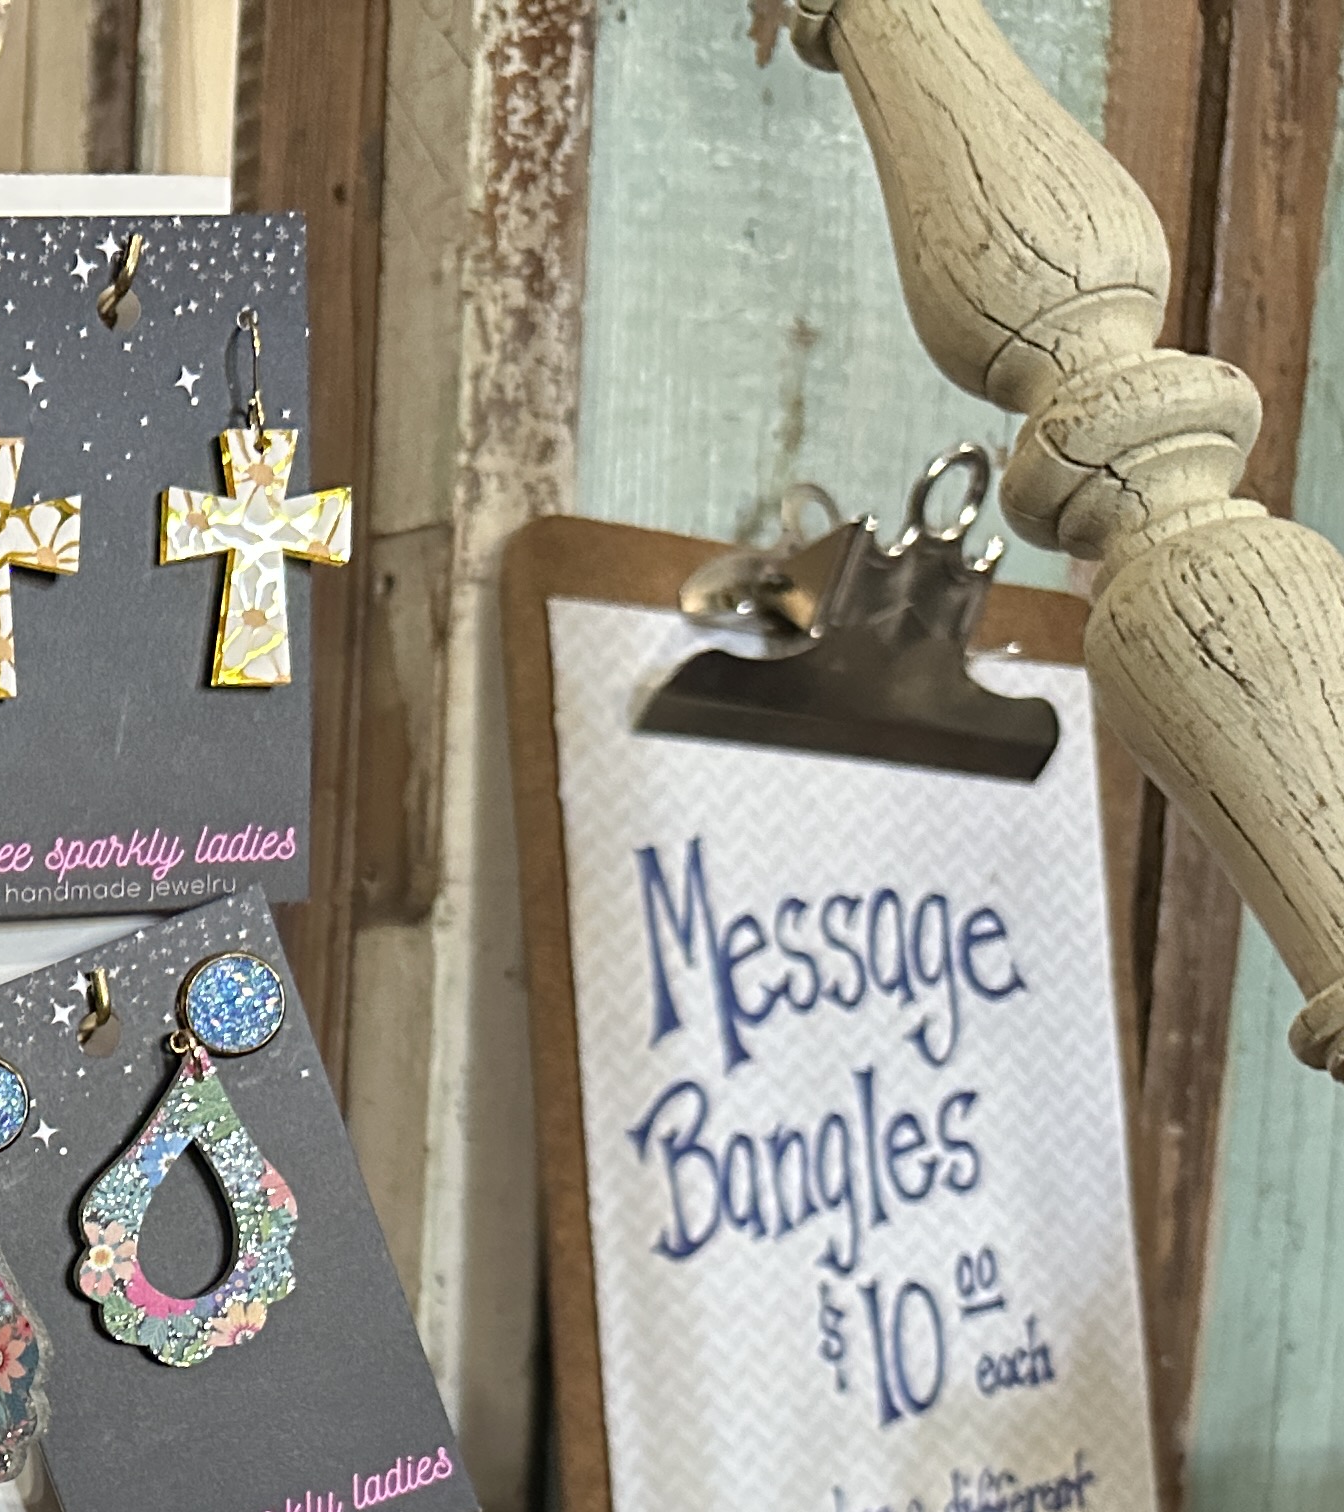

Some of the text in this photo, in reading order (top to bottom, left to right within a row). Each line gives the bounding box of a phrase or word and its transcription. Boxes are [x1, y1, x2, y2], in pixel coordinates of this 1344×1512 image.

[5, 876, 141, 903] handmade
[44, 828, 184, 882] sparkly
[195, 824, 296, 863] ladies
[634, 836, 1027, 1077] Message
[627, 1066, 981, 1276] Bangles
[976, 1312, 1055, 1395] each
[353, 1446, 453, 1510] ladies
